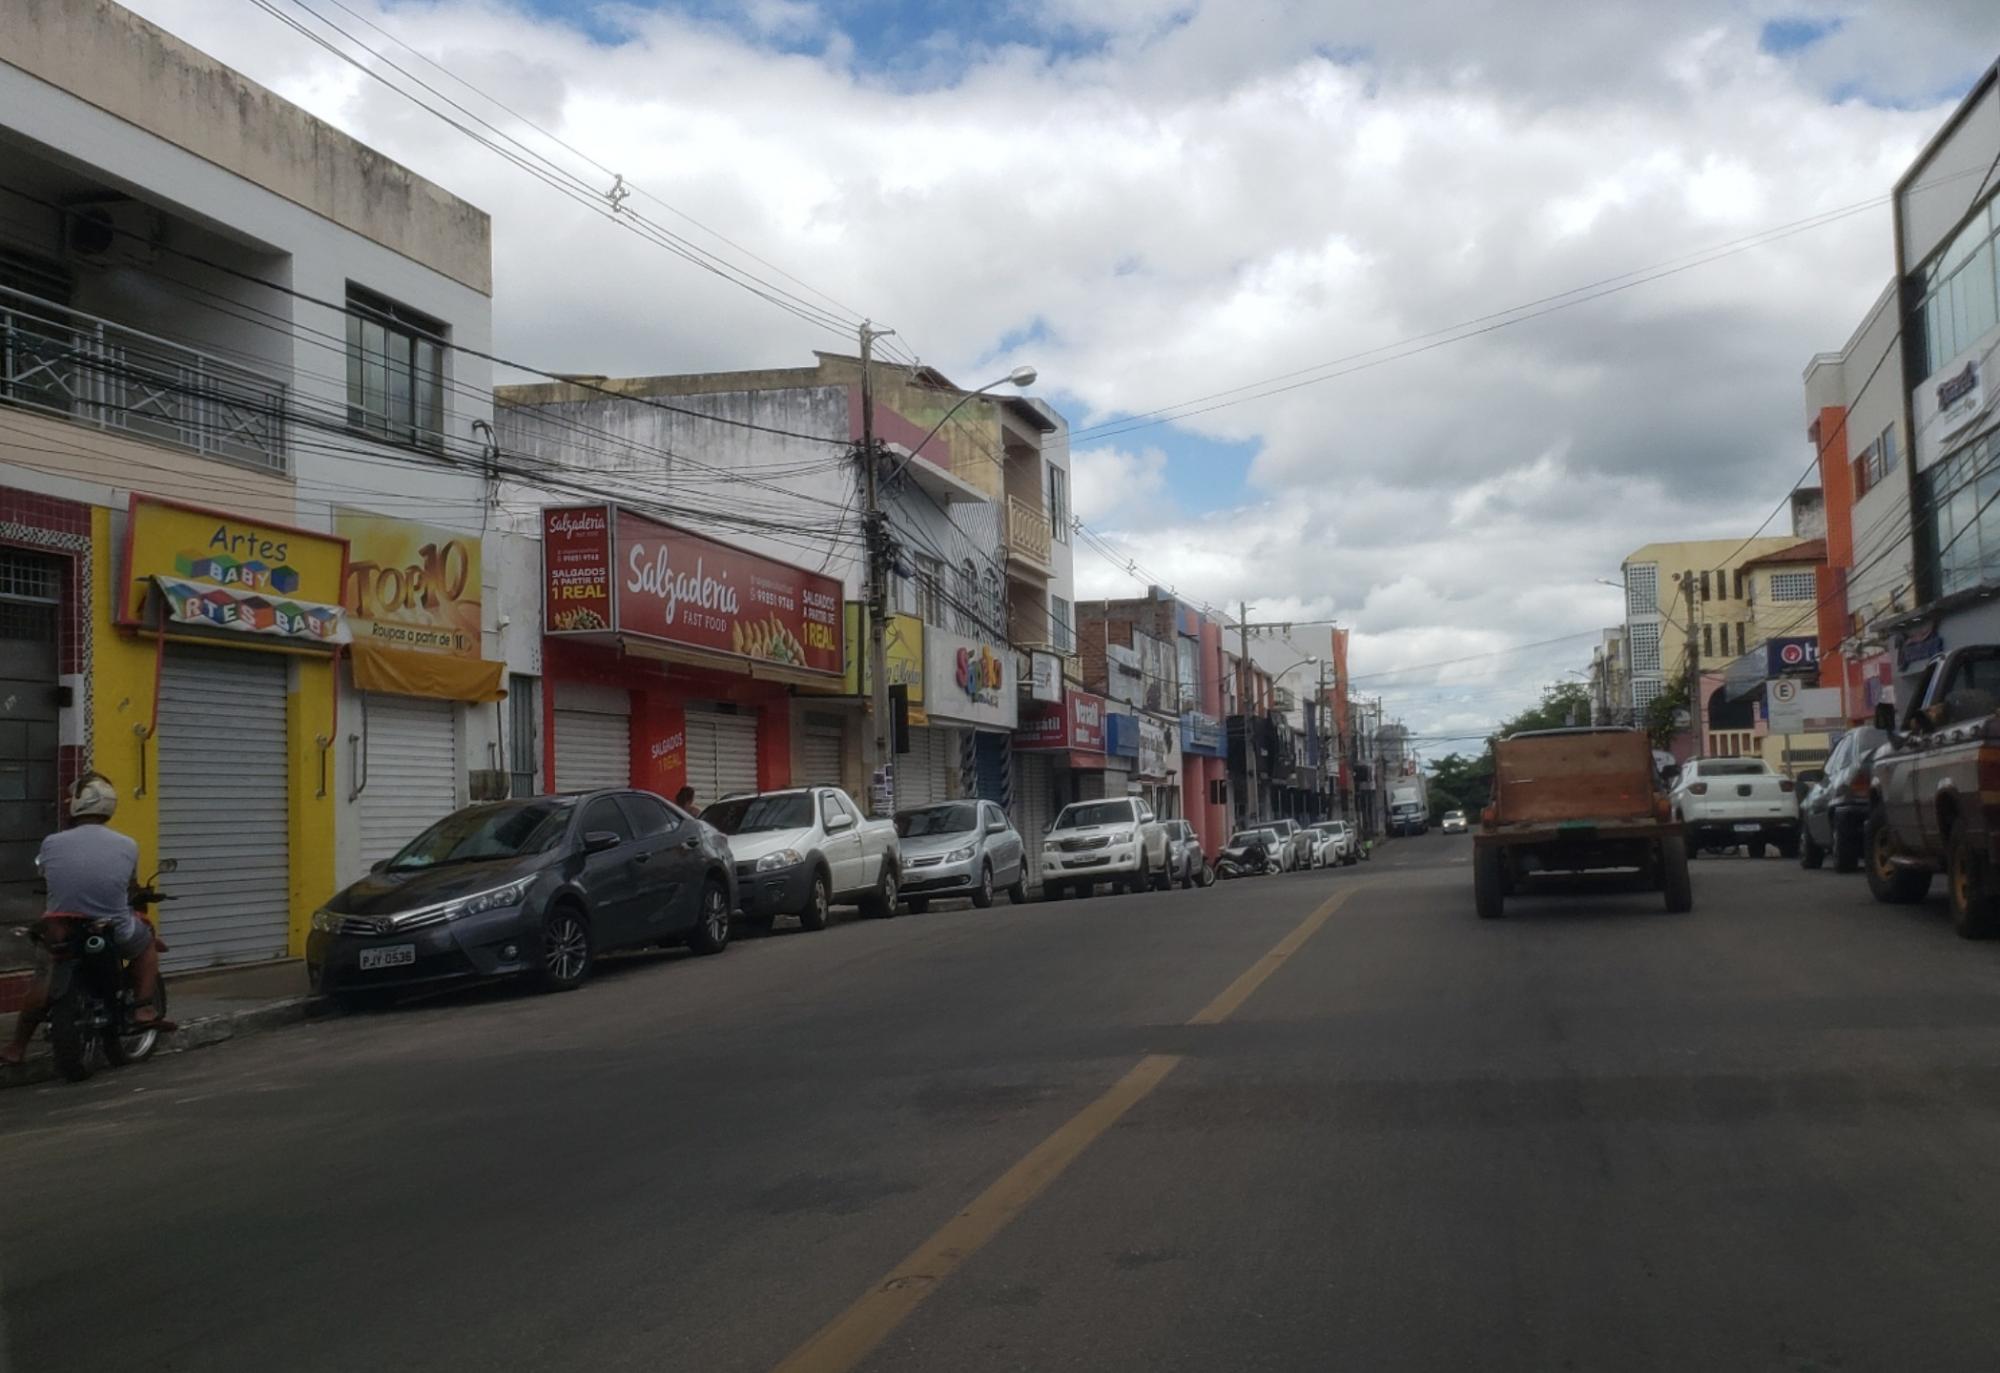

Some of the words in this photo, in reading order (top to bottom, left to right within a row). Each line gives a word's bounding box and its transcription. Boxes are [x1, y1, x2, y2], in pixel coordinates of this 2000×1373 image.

[549, 512, 605, 540] Salgaderia
[208, 525, 288, 562] Artes
[209, 561, 270, 587] BABY
[552, 568, 606, 578] SALGADOS
[552, 578, 559, 586] A
[561, 577, 592, 586] PARTIR
[593, 576, 605, 584] DE
[627, 543, 740, 624] Salgaderia
[552, 587, 558, 600] 1
[563, 585, 606, 599] REAL
[802, 588, 835, 611] SALGADOS
[275, 614, 338, 639] BABY
[683, 610, 703, 627] FAST
[705, 615, 727, 633] FOOD
[808, 607, 827, 623] PARTIR
[372, 622, 405, 641] Roupas
[407, 631, 413, 641] a
[416, 630, 437, 647] partir
[439, 633, 450, 646] de
[802, 621, 808, 645] 1
[808, 622, 836, 650] REAL
[1780, 682, 1789, 698] E
